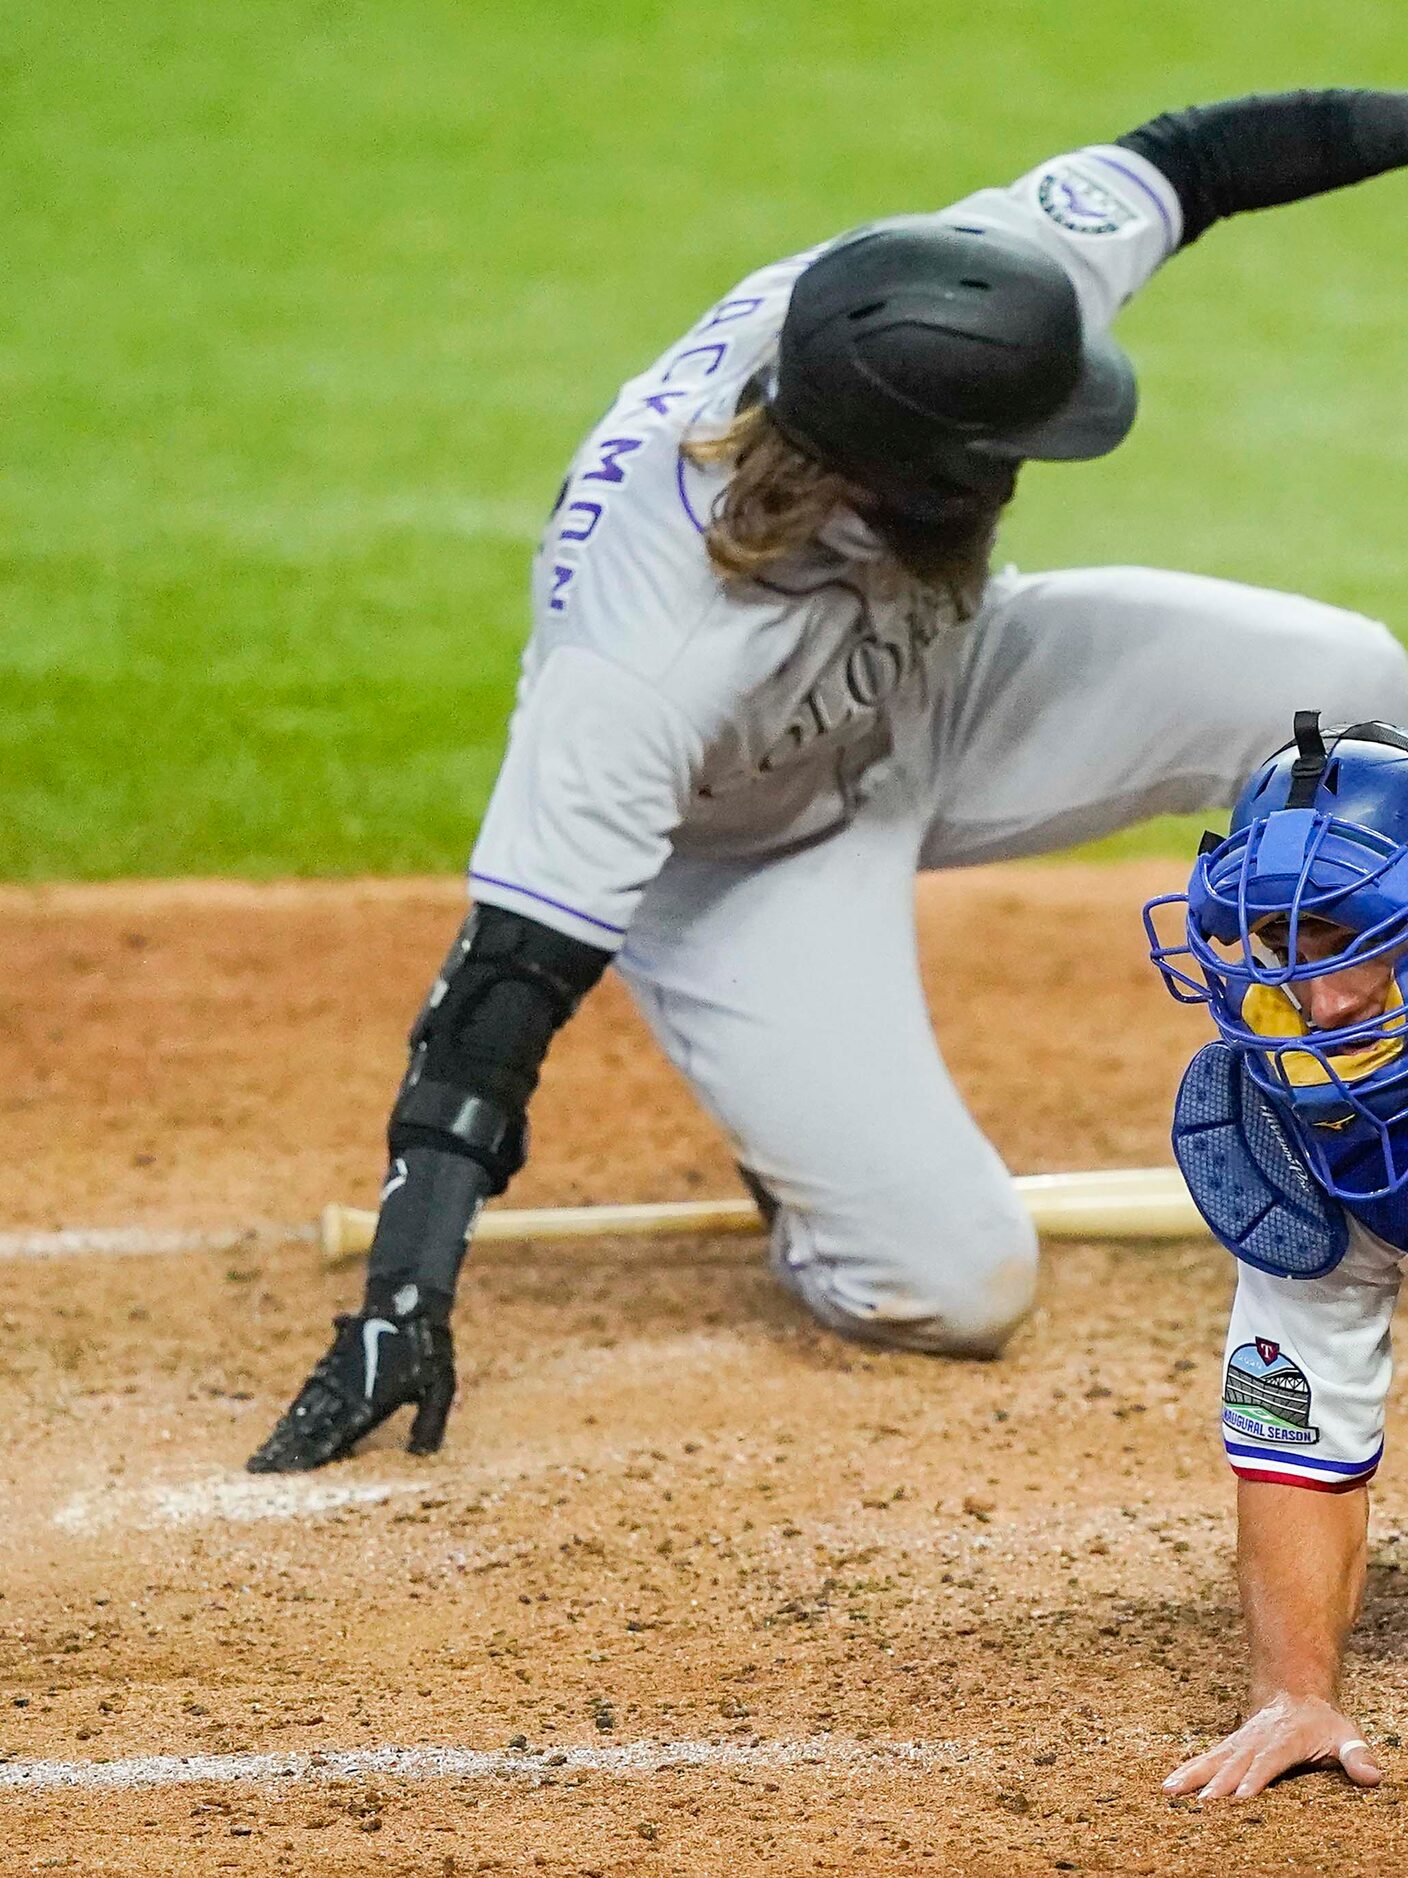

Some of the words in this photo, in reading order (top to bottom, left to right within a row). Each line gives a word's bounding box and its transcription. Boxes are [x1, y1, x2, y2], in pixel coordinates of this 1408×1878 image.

[548, 297, 763, 611] ACKMON
[1260, 1343, 1274, 1360] T
[1221, 1407, 1266, 1437] NAUGURAL
[1267, 1426, 1312, 1442] SEASON
